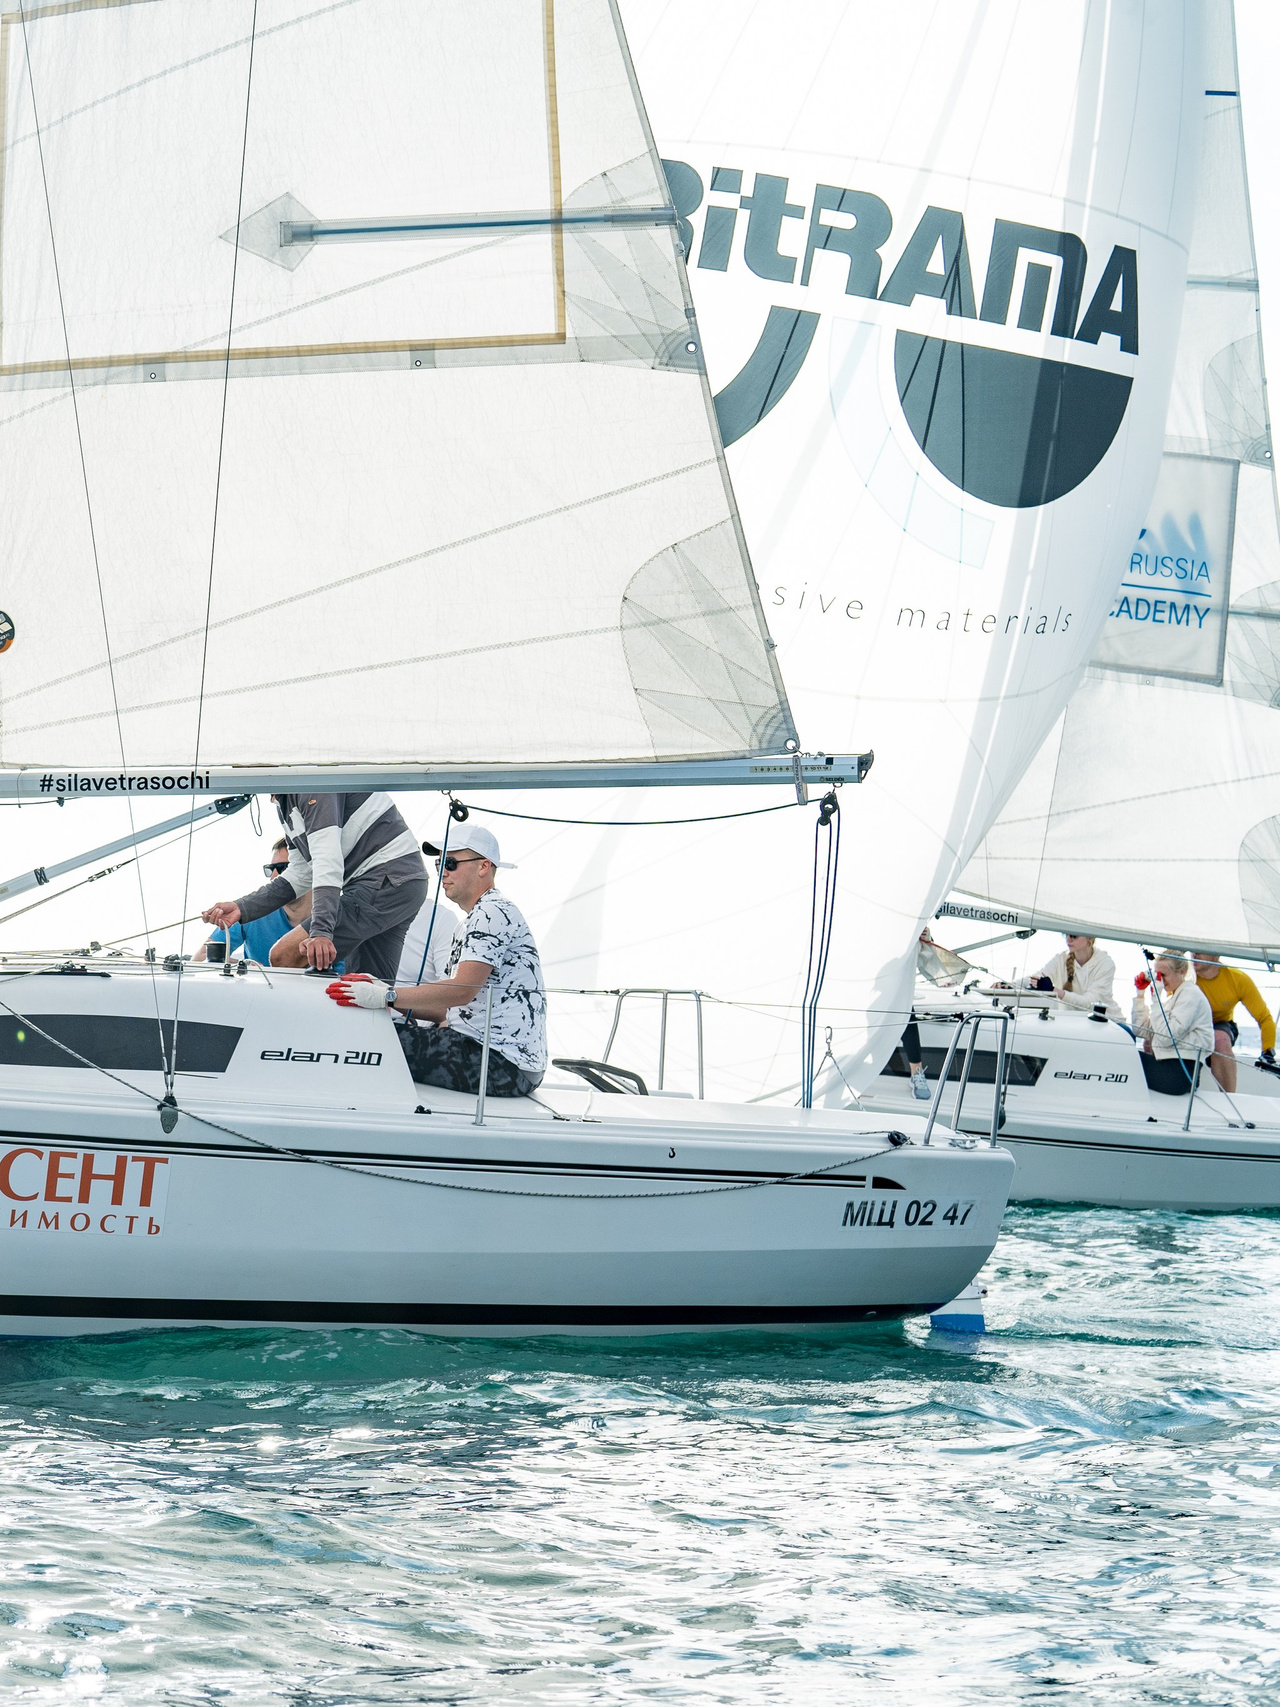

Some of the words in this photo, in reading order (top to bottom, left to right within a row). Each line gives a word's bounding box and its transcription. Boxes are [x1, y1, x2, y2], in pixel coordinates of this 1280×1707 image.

[1129, 552, 1211, 584] RUSSIA
[772, 582, 864, 620] sive
[896, 605, 1073, 635] materials
[1109, 596, 1211, 629] ADEMY
[39, 770, 210, 793] #silavetrasochi
[260, 1047, 340, 1064] elan
[344, 1050, 383, 1066] 210
[1053, 1070, 1102, 1082] elan
[1104, 1073, 1129, 1083] 210
[904, 1199, 938, 1227] 02
[942, 1198, 978, 1226] 47
